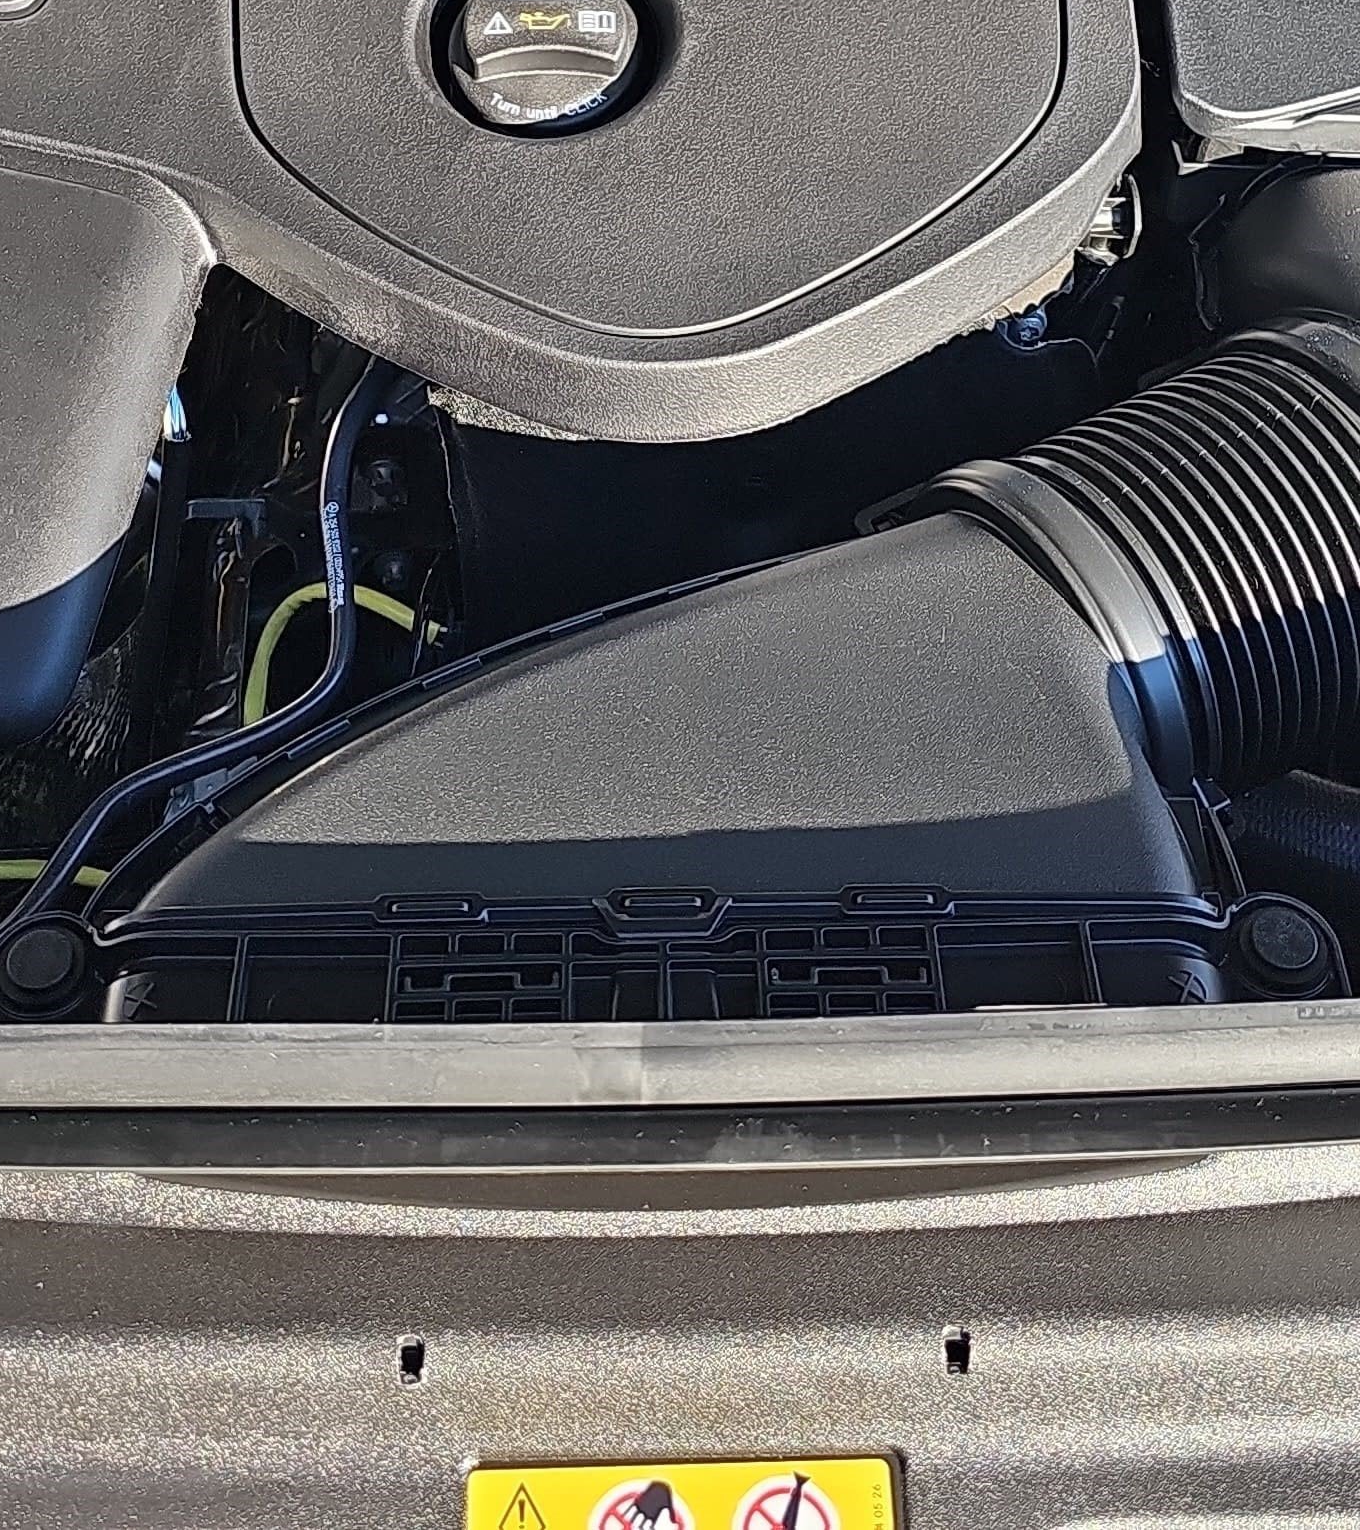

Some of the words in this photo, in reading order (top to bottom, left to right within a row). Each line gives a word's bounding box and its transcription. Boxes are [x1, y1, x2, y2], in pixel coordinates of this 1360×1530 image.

[490, 92, 521, 116] Turn
[525, 104, 560, 120] until
[563, 90, 608, 116] CLICK
